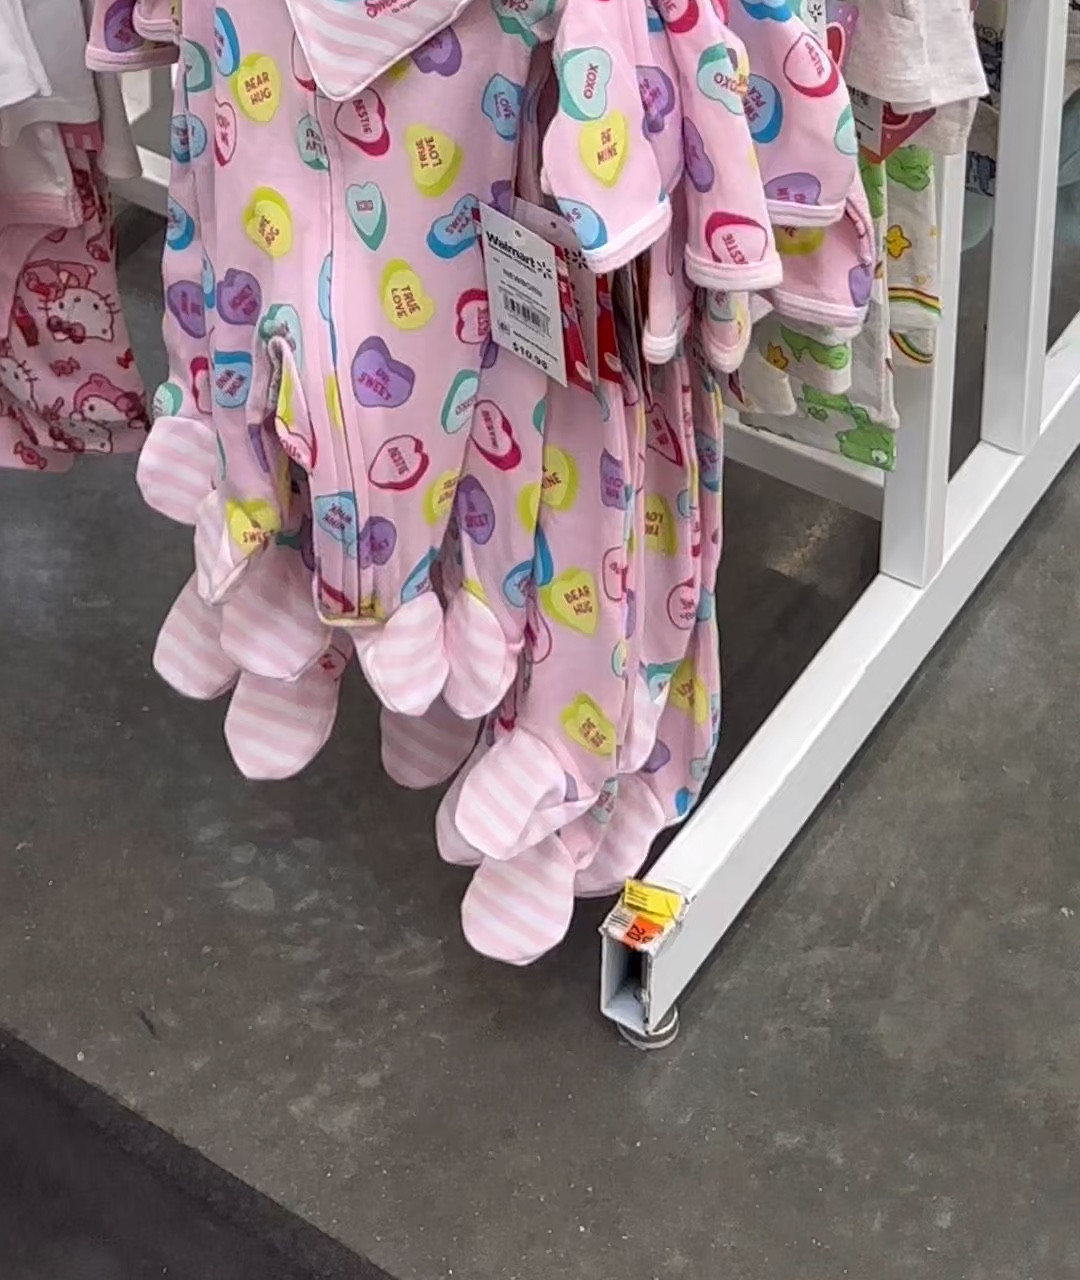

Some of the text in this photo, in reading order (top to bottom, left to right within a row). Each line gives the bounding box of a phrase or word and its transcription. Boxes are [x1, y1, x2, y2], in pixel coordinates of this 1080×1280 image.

[243, 70, 271, 94] BEAR
[249, 86, 273, 106] HUG
[600, 126, 613, 145] BE
[596, 141, 620, 166] MINE
[485, 229, 537, 268] Walmart
[390, 286, 408, 320] LOVE
[400, 283, 421, 316] TRUE
[564, 585, 591, 605] BEAR
